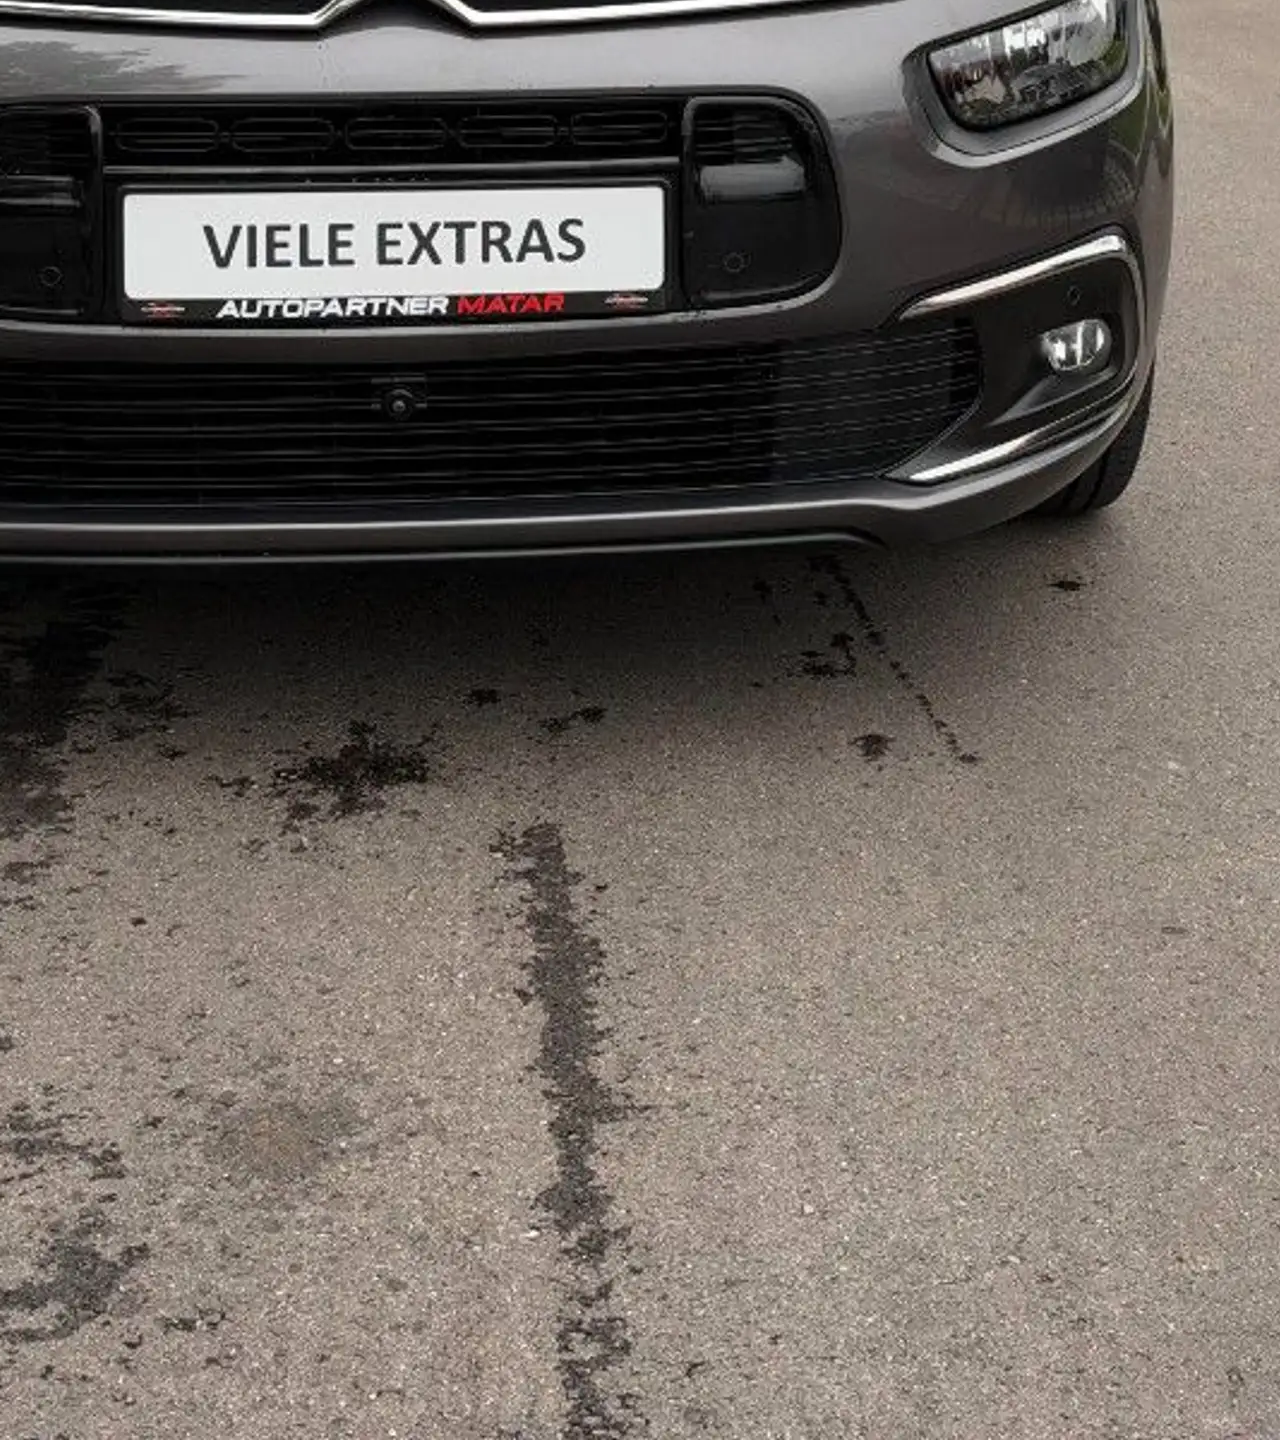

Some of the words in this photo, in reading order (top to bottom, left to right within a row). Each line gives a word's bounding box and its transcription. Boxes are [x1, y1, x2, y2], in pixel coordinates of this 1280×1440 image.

[202, 222, 356, 269] VIELE
[376, 217, 586, 266] EXTRAS
[215, 296, 449, 318] AUTOPARTNER
[456, 292, 564, 314] MATAR
